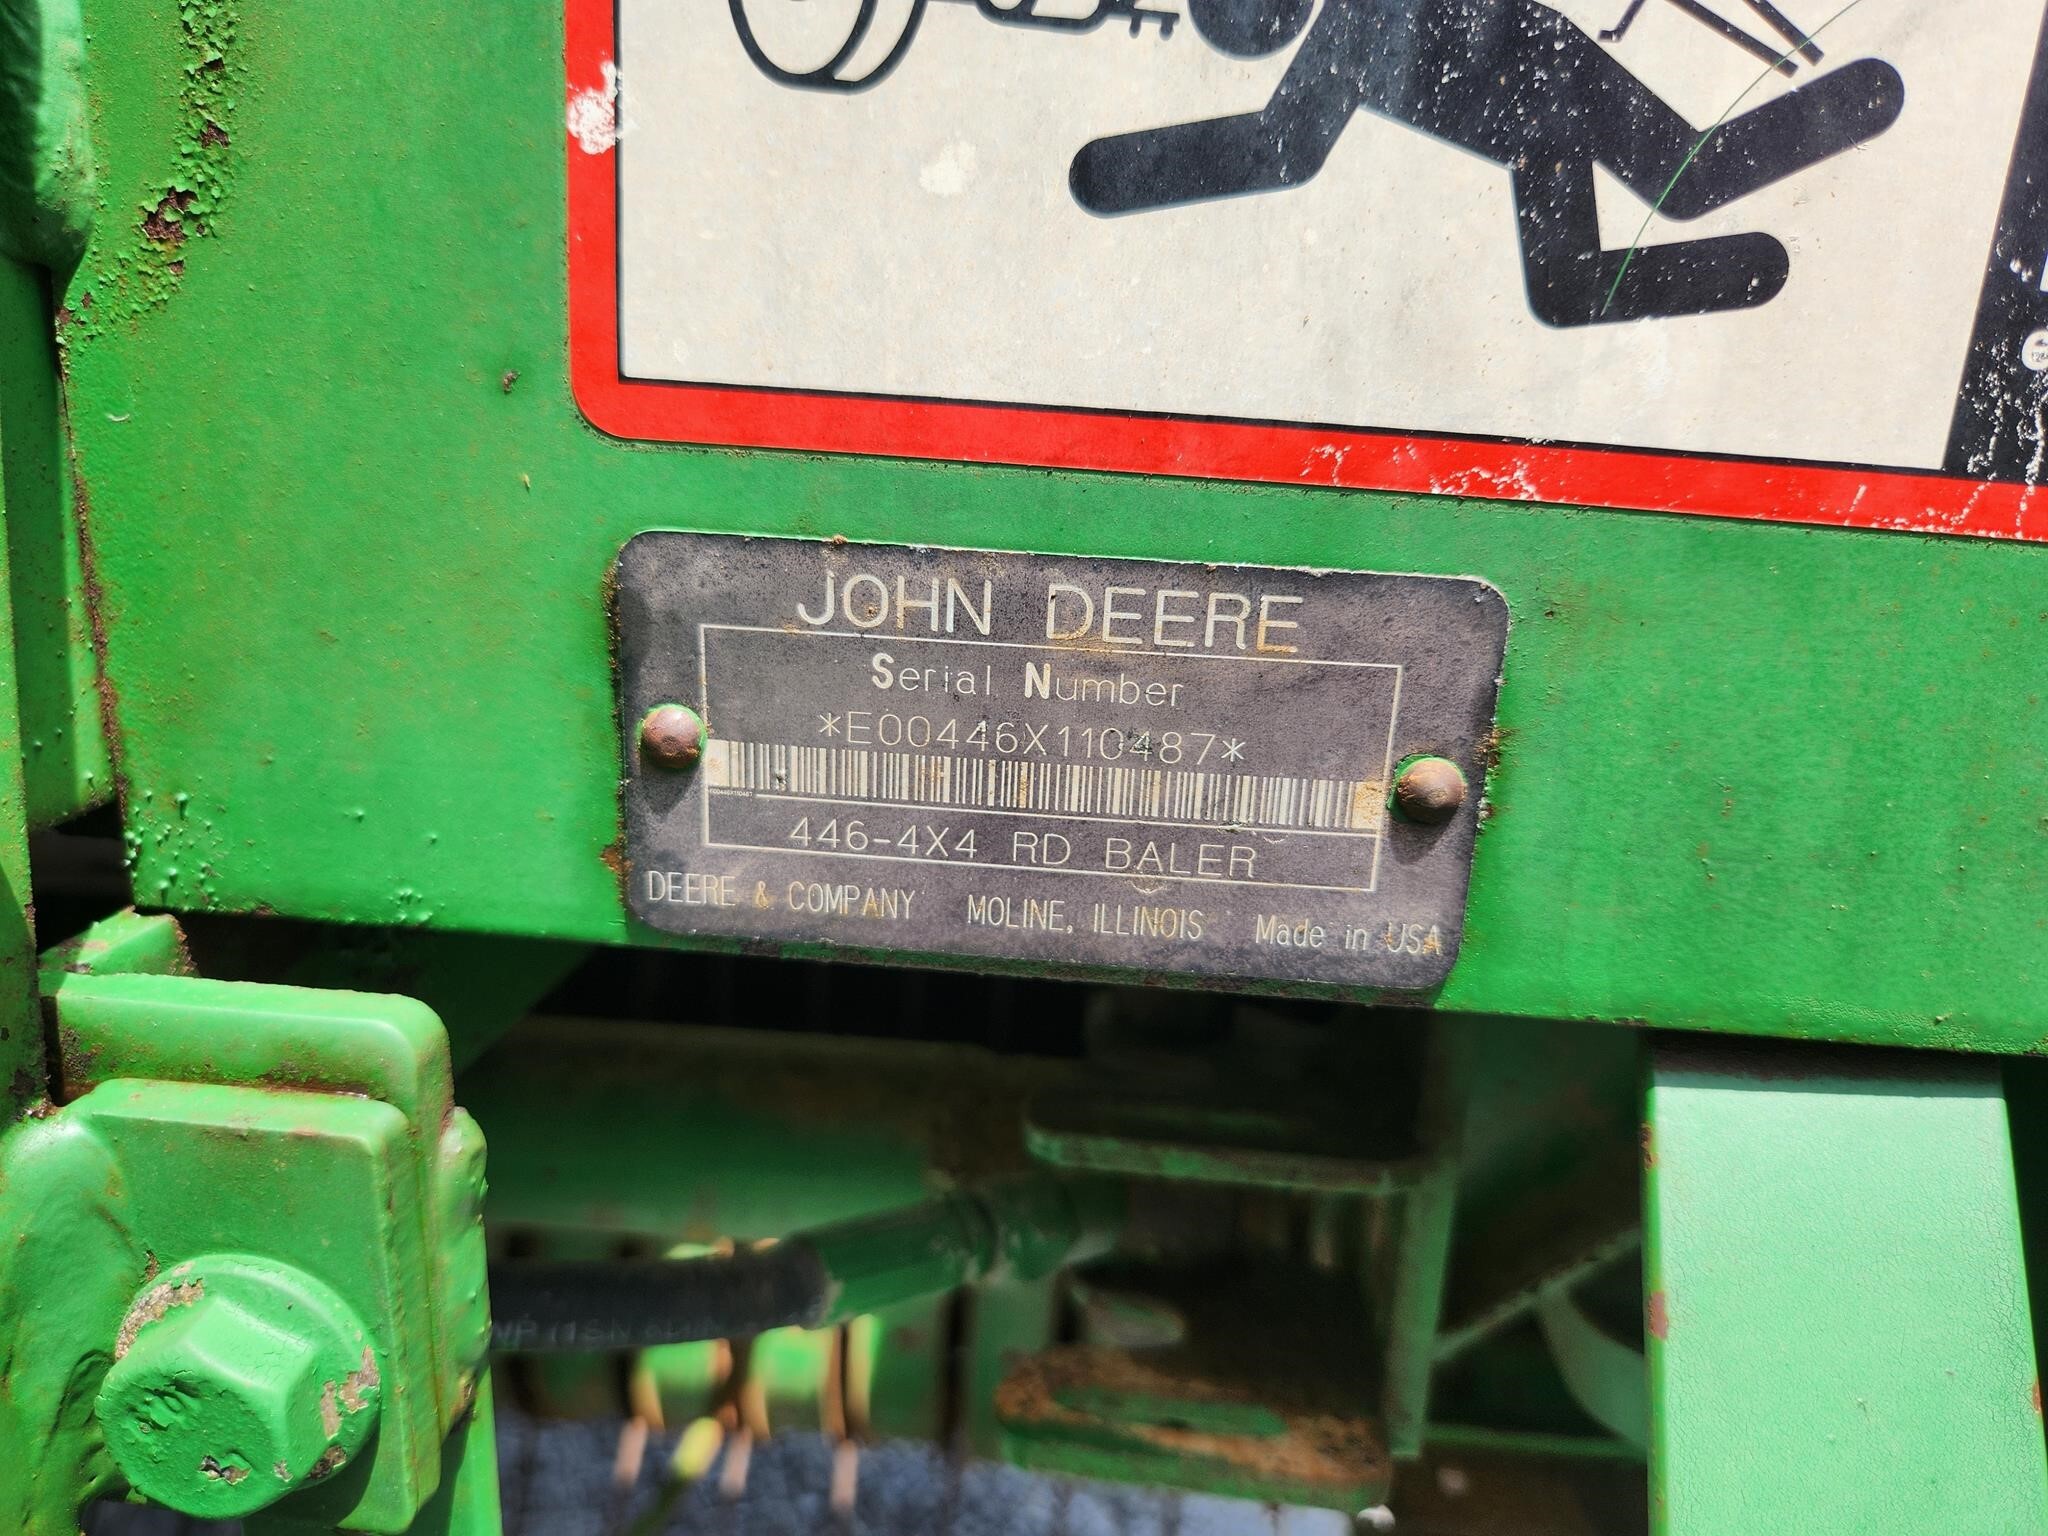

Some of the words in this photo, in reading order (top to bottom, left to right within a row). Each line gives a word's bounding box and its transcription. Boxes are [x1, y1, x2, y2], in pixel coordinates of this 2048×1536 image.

[797, 571, 993, 636] JOHN
[1046, 583, 1304, 653] DEERE
[871, 652, 992, 696] Serial
[1023, 662, 1184, 707] Number
[789, 816, 978, 859] 446-4X4
[1012, 831, 1072, 866] RD
[1104, 838, 1258, 879] BALER
[647, 869, 737, 907] DEERE
[756, 880, 771, 911] &
[788, 881, 916, 920] COMPANY
[967, 894, 1073, 934] MOLINE,
[1093, 902, 1204, 941] ILLINOIS
[1255, 913, 1326, 949] Made
[1345, 922, 1369, 952] in
[1383, 921, 1443, 956] USA
